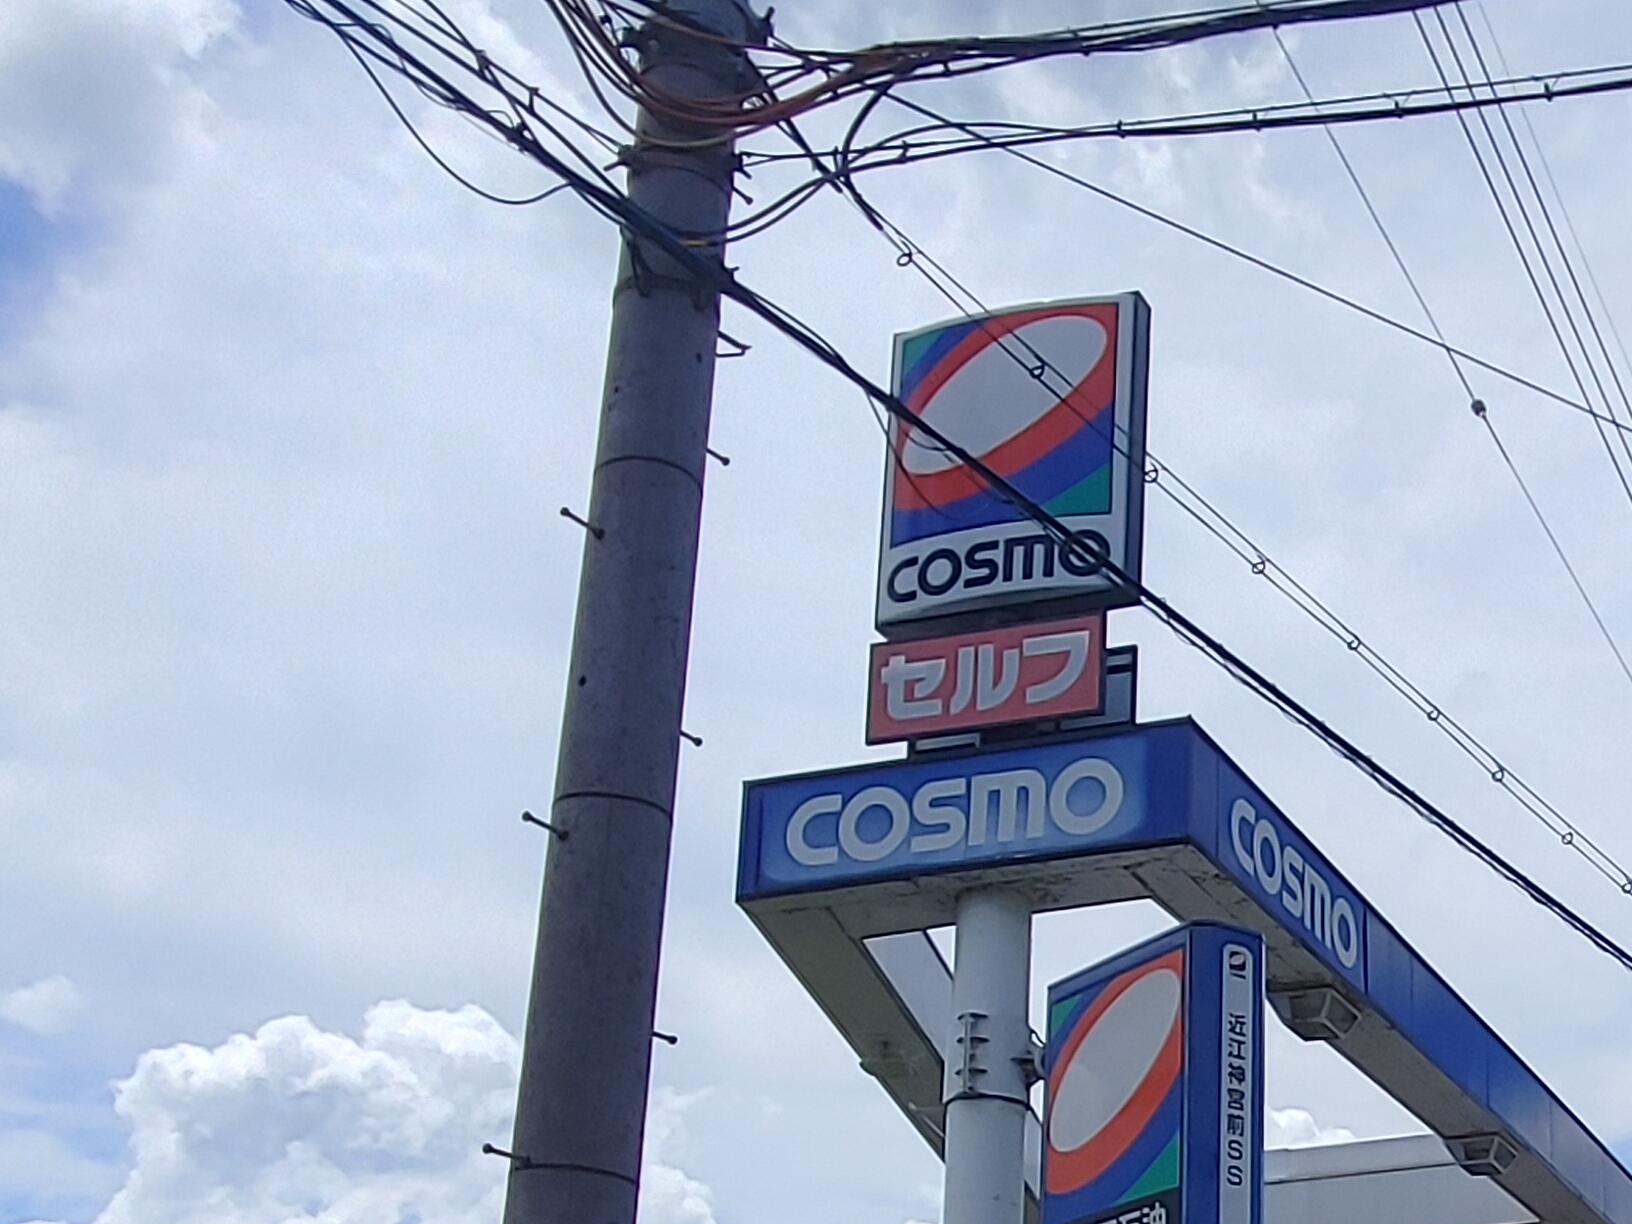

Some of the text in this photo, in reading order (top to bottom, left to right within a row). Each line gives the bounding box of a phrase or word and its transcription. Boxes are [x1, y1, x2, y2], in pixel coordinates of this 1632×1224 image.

[887, 529, 1111, 603] COSMO
[881, 630, 1090, 721] セルフ
[785, 757, 1124, 866] COSMO
[1231, 798, 1358, 969] COSMO
